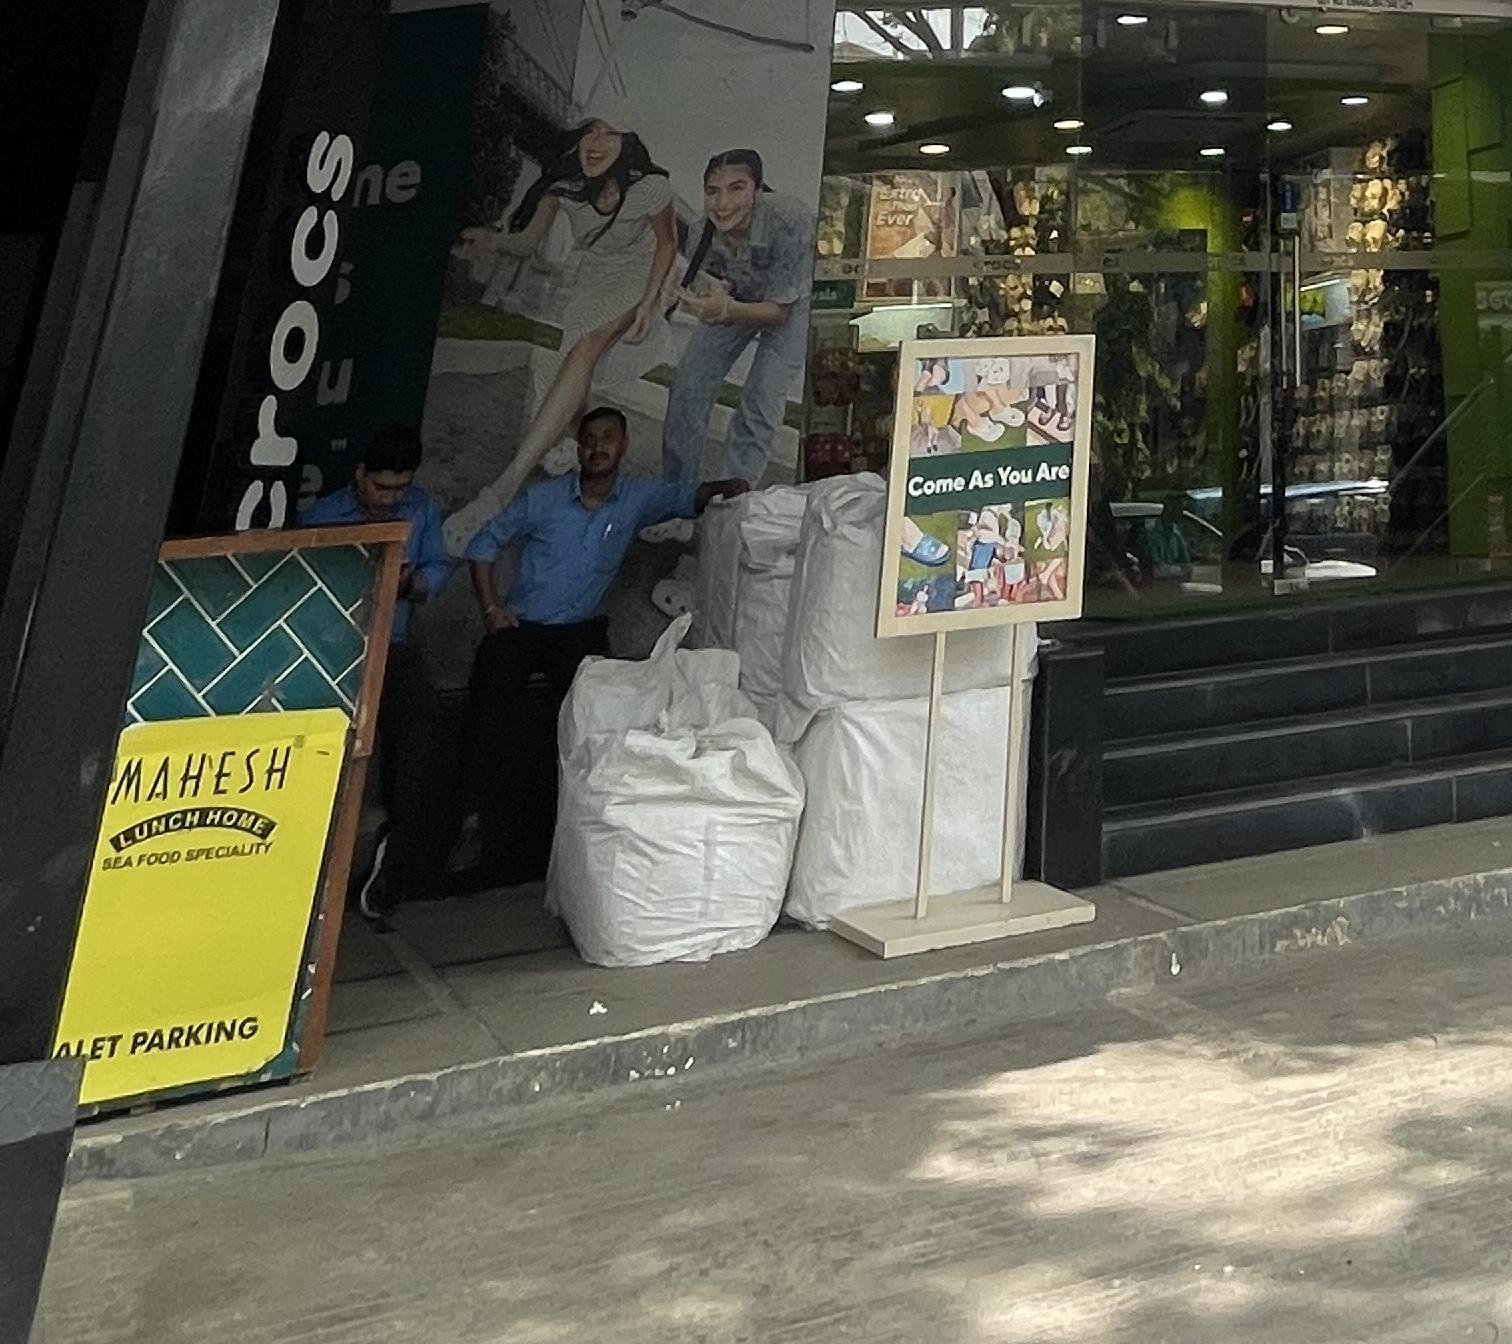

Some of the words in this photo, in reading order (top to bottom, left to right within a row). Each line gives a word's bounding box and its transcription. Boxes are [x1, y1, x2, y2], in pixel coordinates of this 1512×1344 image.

[908, 476, 966, 497] Come
[968, 469, 994, 491] As
[997, 465, 1034, 487] You
[1036, 462, 1070, 482] Are
[110, 744, 293, 806] MAHESH
[119, 810, 200, 848] LUNCH
[205, 808, 272, 835] HOME
[102, 853, 133, 872] SEA
[137, 849, 181, 868] FOOD
[185, 840, 275, 863] SPECIALITY
[53, 1033, 124, 1062] ALET
[129, 1016, 260, 1056] PARKING
